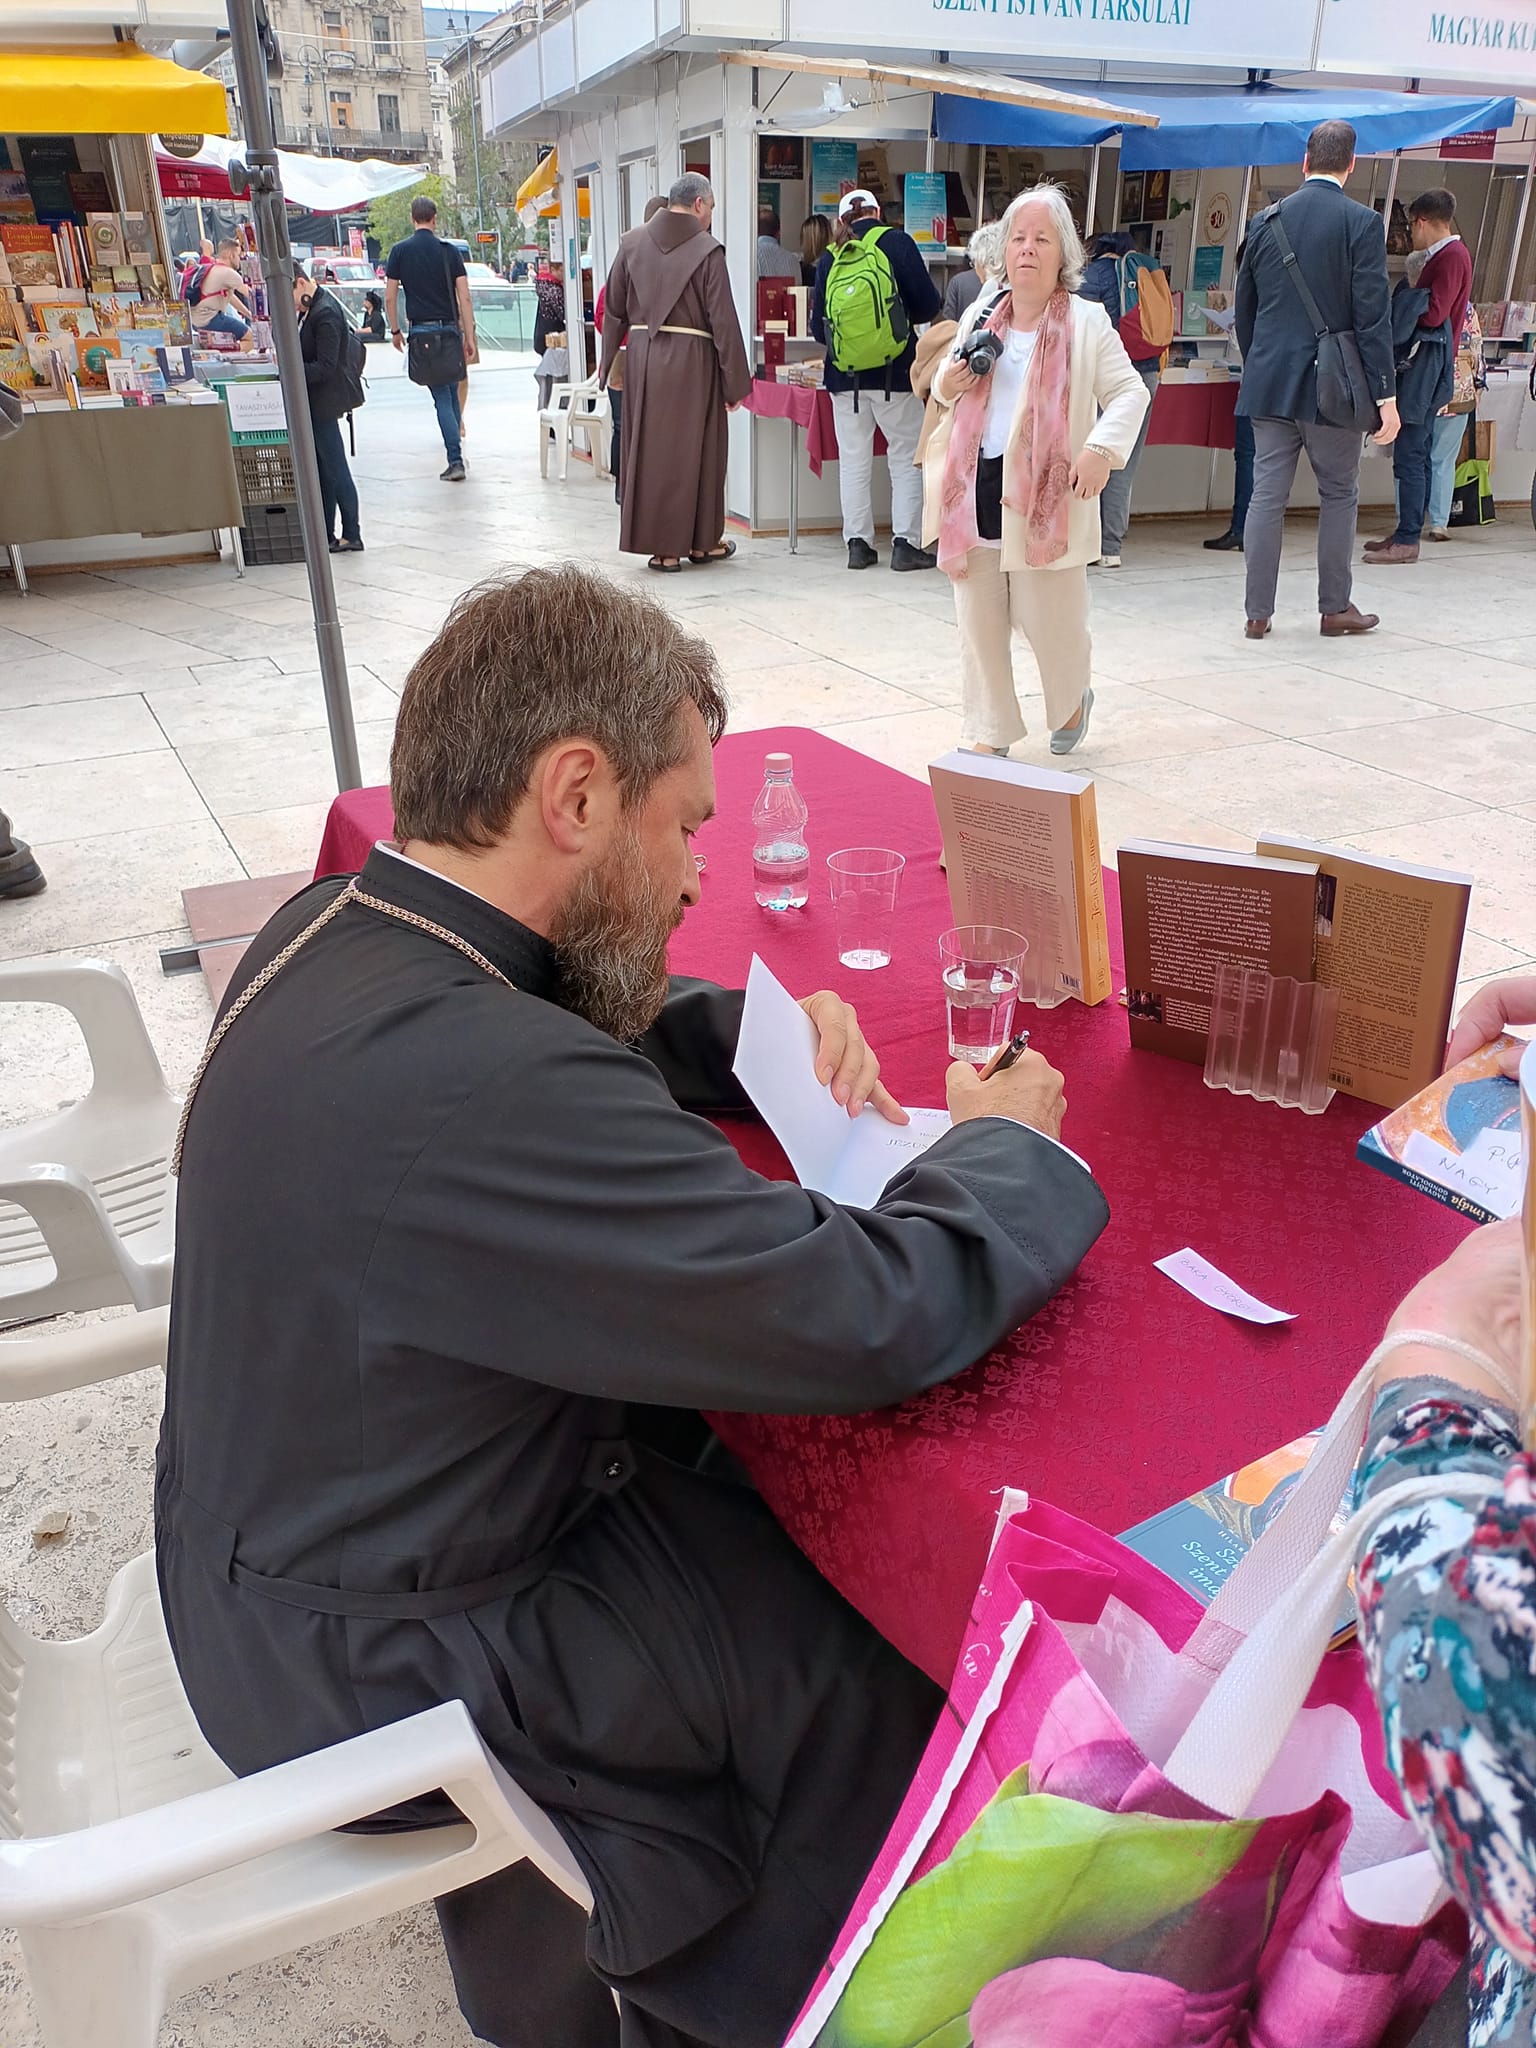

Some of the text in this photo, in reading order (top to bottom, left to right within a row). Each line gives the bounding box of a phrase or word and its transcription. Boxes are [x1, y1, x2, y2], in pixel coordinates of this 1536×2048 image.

[1427, 13, 1505, 48] MAGYAR
[1401, 1168, 1449, 1196] GONDOLATOK
[1409, 1178, 1447, 1202] NAGYBÖJTI
[1438, 1156, 1499, 1195] NAGY
[1450, 1195, 1486, 1221] imája
[1182, 1541, 1227, 1576] Szent
